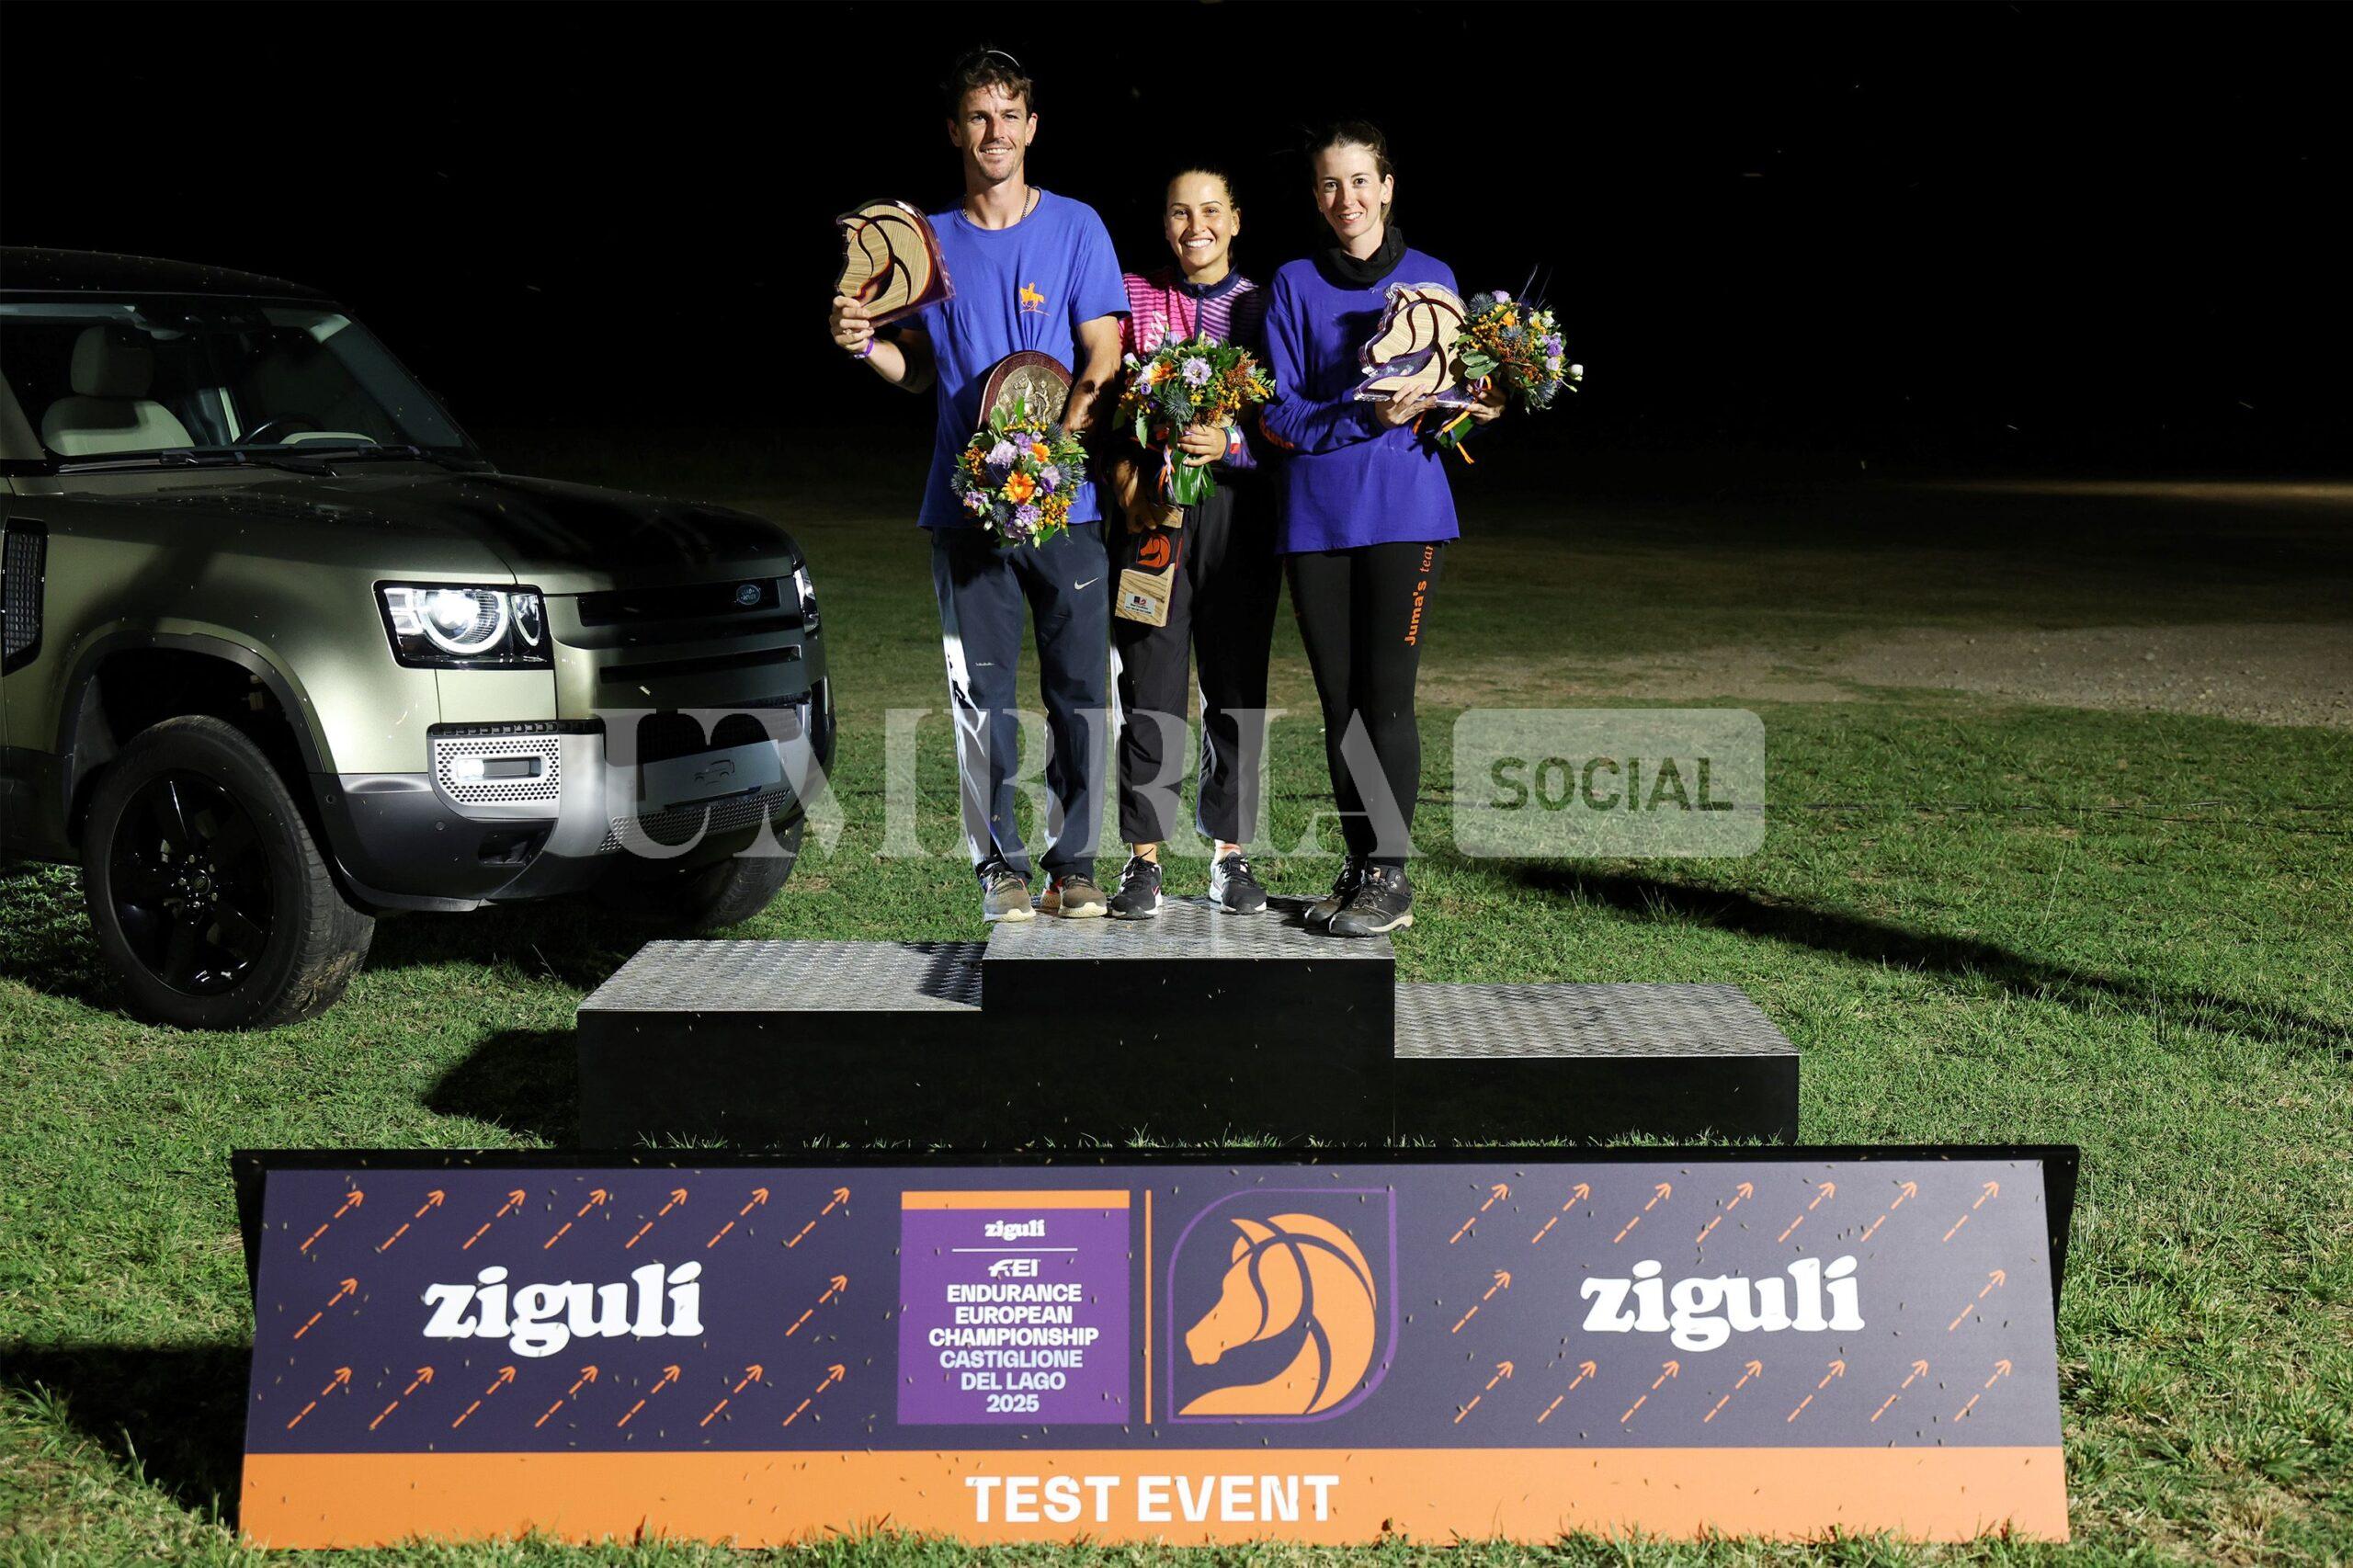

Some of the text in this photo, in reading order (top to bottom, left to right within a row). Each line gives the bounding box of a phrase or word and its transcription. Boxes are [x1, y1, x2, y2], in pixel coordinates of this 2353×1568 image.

[1404, 580, 1427, 647] Juma's
[988, 1258, 1039, 1278] FEI
[947, 1284, 1082, 1302] ENDURANCE
[955, 1306, 1073, 1324] EUROPEAN
[928, 1327, 1099, 1346] CHAMPIONSHIP
[939, 1349, 1083, 1368] CASTIGLIONE
[961, 1371, 1066, 1391] DEL LAGO
[985, 1393, 1040, 1413] 2025
[965, 1475, 1339, 1523] TEST EVENT
